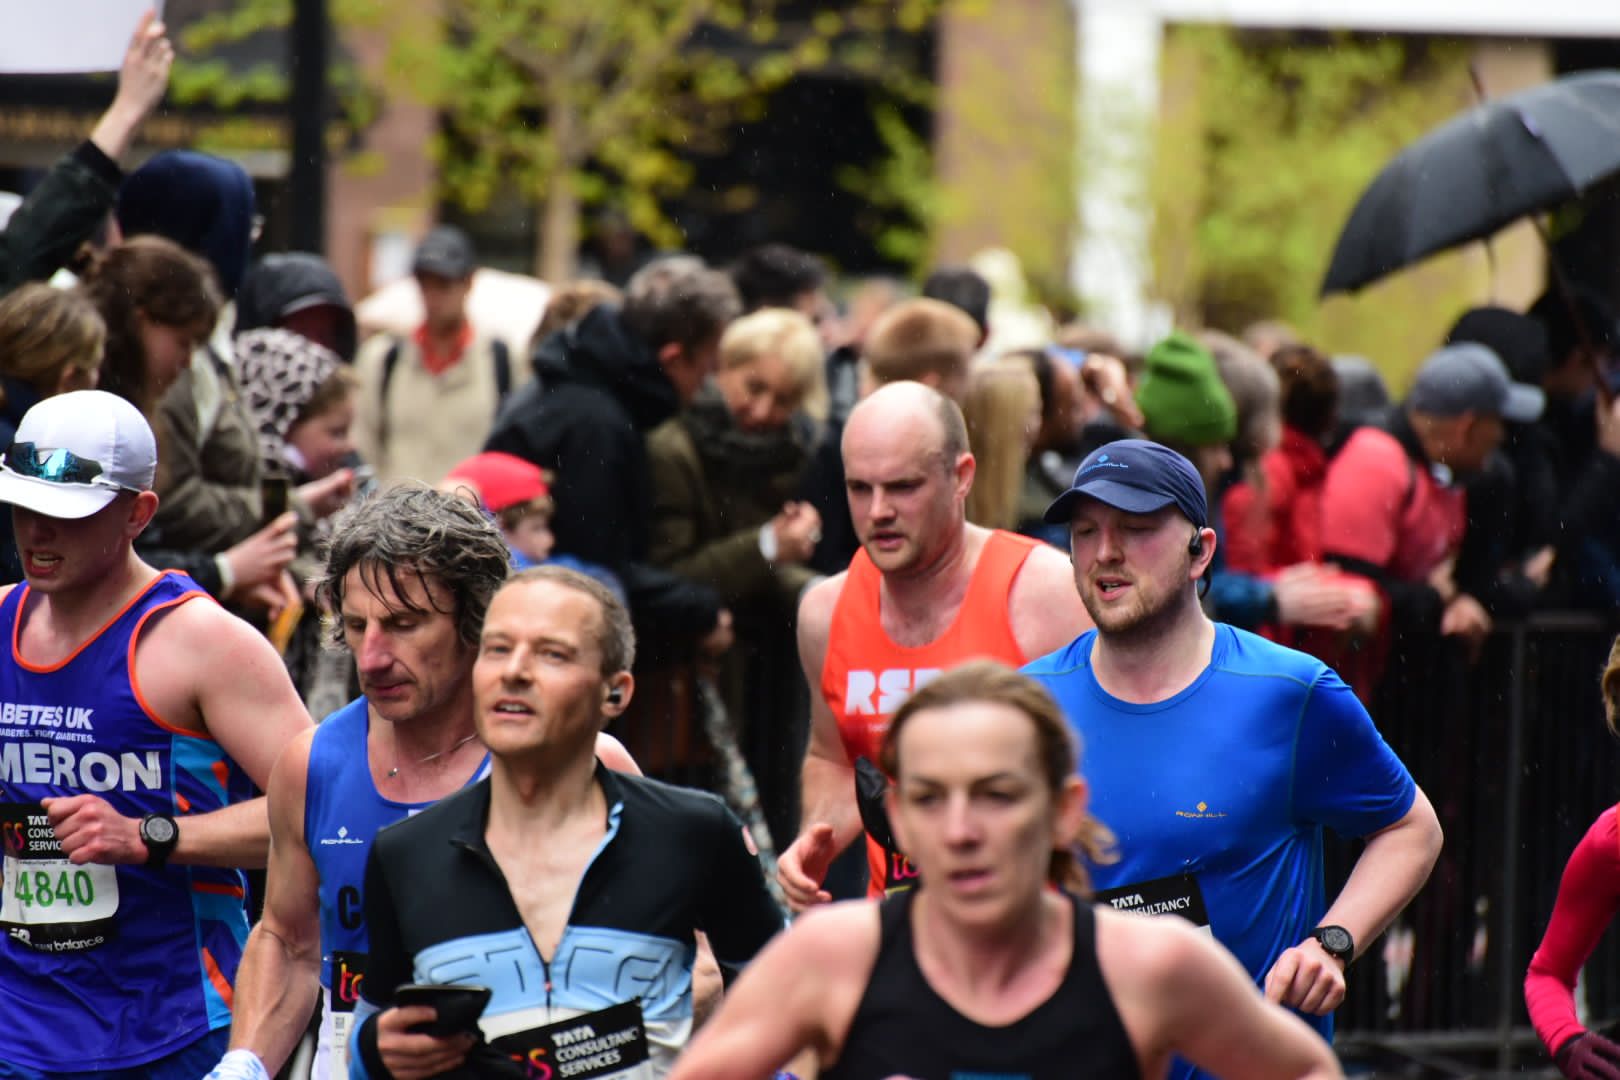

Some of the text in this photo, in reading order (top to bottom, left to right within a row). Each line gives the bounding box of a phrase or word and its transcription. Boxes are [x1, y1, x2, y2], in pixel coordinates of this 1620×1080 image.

[0, 702, 94, 730] BETES UK
[0, 742, 161, 792] MERON
[27, 815, 51, 826] TAT
[28, 828, 56, 839] CONS
[29, 840, 62, 851] SERVIC
[15, 870, 94, 908] 4840
[1110, 893, 1144, 910] TATA
[54, 936, 105, 951] balance
[552, 1024, 596, 1047] TATA
[558, 1049, 623, 1078] SERVICES
